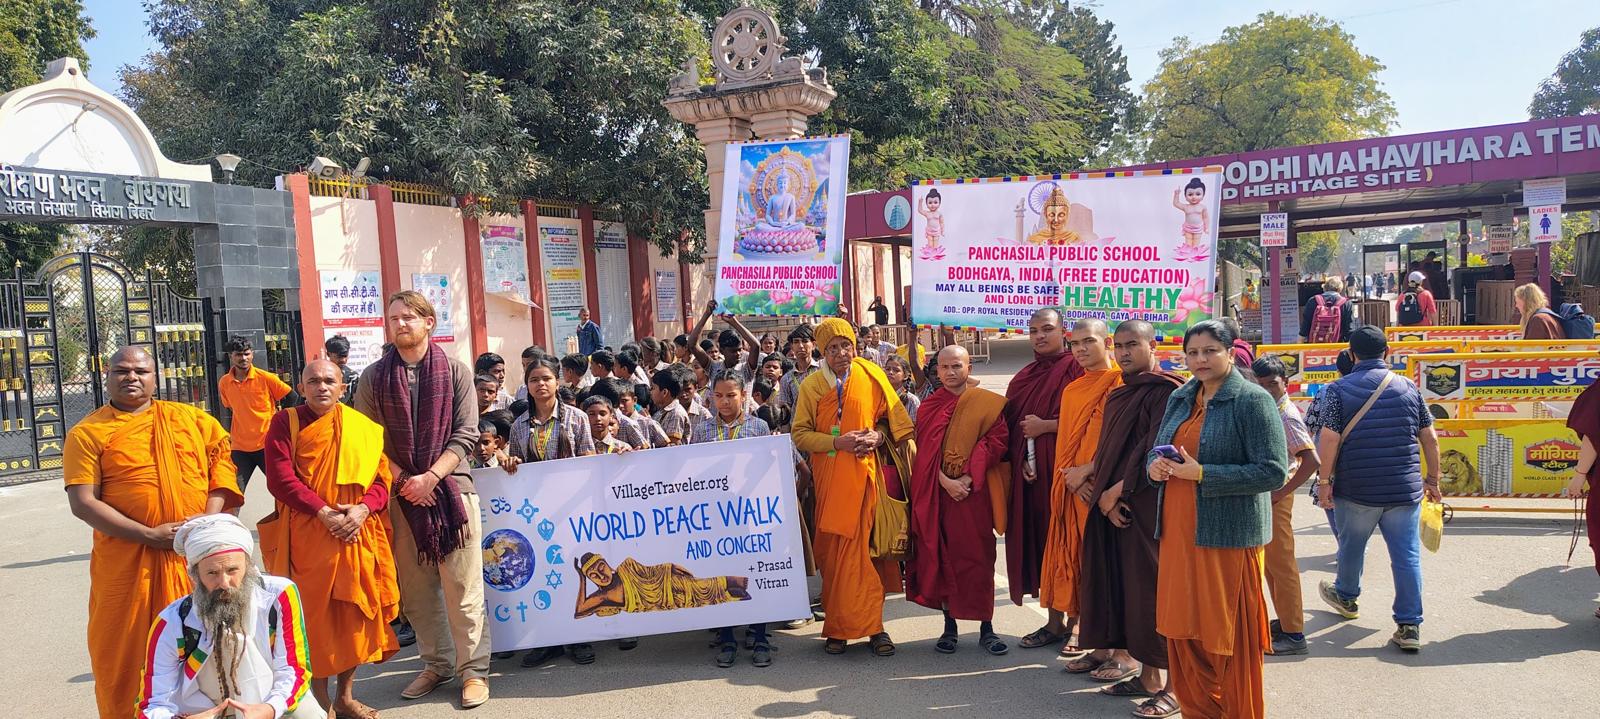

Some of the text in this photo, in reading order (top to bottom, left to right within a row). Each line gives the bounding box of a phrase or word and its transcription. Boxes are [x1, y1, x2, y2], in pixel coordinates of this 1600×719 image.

[1222, 155, 1301, 185] ODHI
[1308, 132, 1532, 177] MAHAVIHARA
[60, 175, 107, 202] भवन
[1243, 177, 1359, 199] HERITAGE
[968, 247, 1160, 262] PANCHASILA PUBLIC SCHOOL
[721, 266, 837, 279] PANCHASILA PUBLIC SCHOOL
[948, 267, 1190, 287] BODHGAYA, INDIA (FREE EDUCATION)
[740, 280, 815, 290] BODHGAYA, INDIA
[324, 287, 338, 299] आप
[936, 284, 1183, 310] MAY ALL BEINGS BE SAFE HEALTHY
[984, 295, 1060, 306] AND LONG LIFE
[330, 301, 341, 313] की
[978, 307, 1000, 316] ROYAL
[1001, 308, 1036, 316] RESIDENC
[1110, 312, 1129, 321] GAYA
[1144, 313, 1169, 322] BIHAR
[1006, 318, 1025, 327] NEAR
[1467, 366, 1541, 379] गया
[1467, 386, 1493, 396] पुलिस
[1495, 387, 1529, 395] सहायता
[1542, 460, 1569, 469] स्टील
[611, 476, 729, 499] VillageTraveler.org
[569, 495, 783, 543] WORLD PEACE WALK
[686, 532, 772, 560] AND CONCERT
[757, 557, 793, 574] Prasad
[755, 577, 790, 591] Vitran
